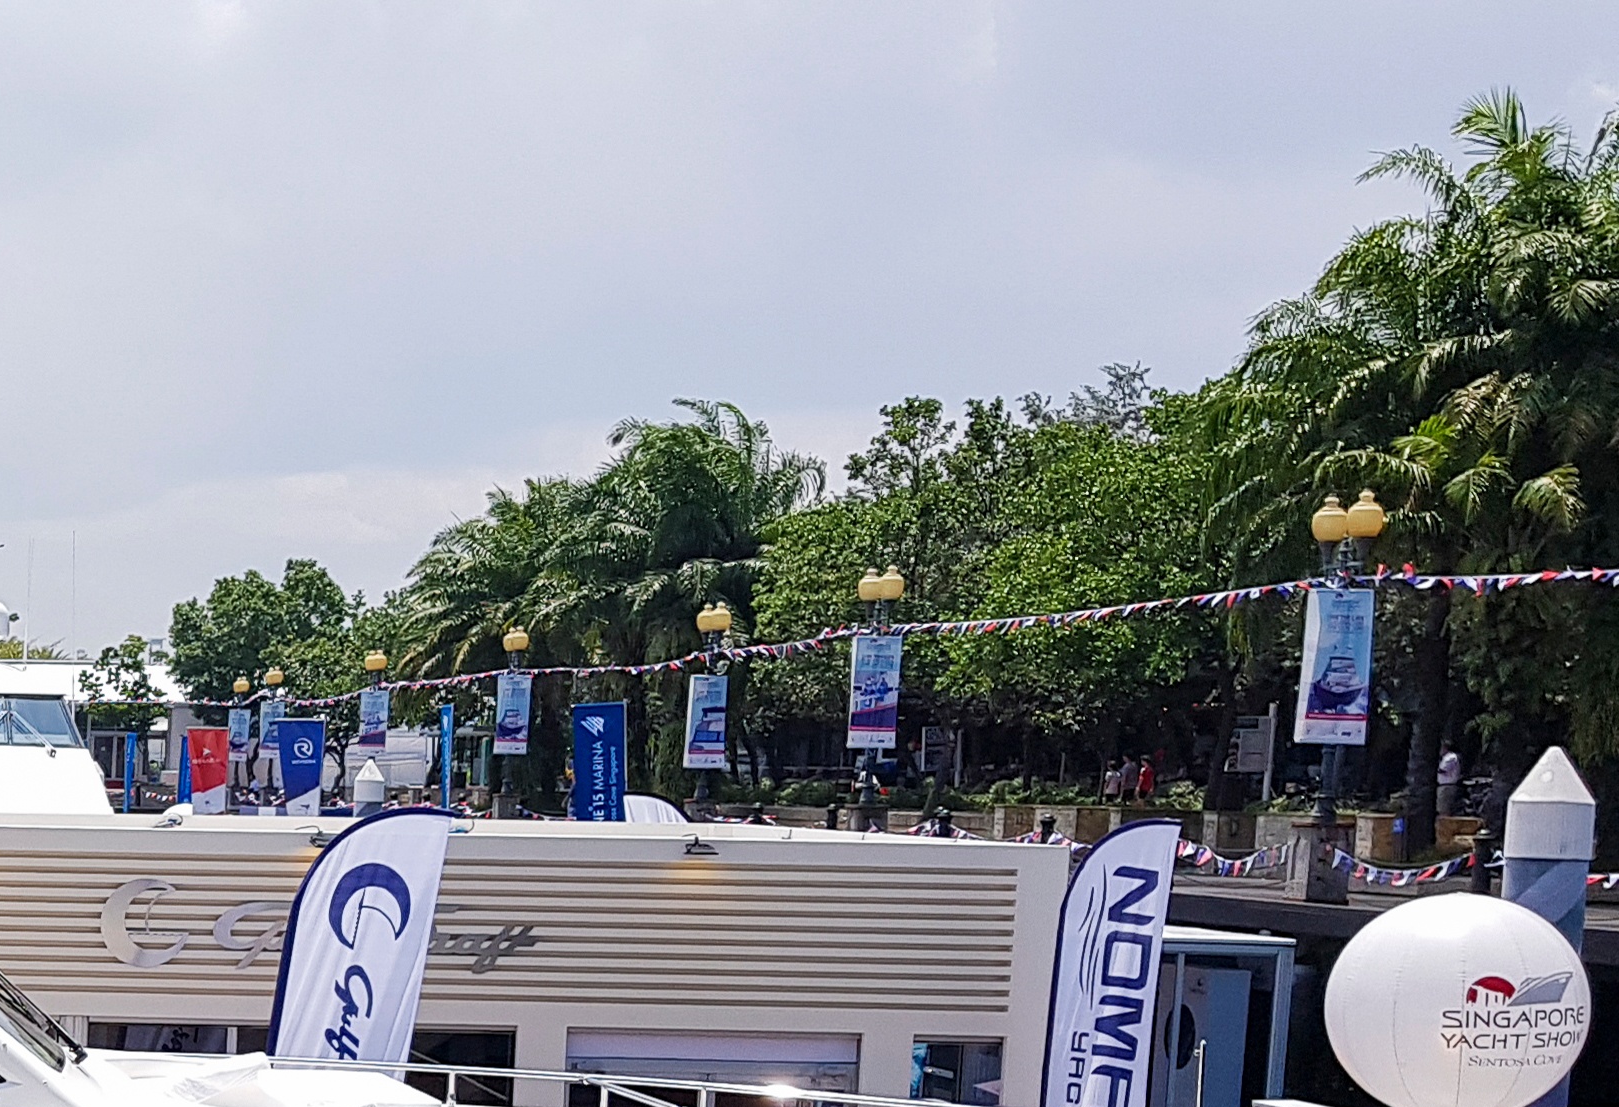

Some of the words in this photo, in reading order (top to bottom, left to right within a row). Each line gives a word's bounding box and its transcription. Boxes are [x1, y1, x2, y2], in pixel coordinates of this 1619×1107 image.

[592, 741, 604, 790] MARINA
[1442, 1006, 1585, 1029] SINGAPORE
[1440, 1032, 1527, 1050] YACHT
[1532, 1029, 1584, 1049] SHOW
